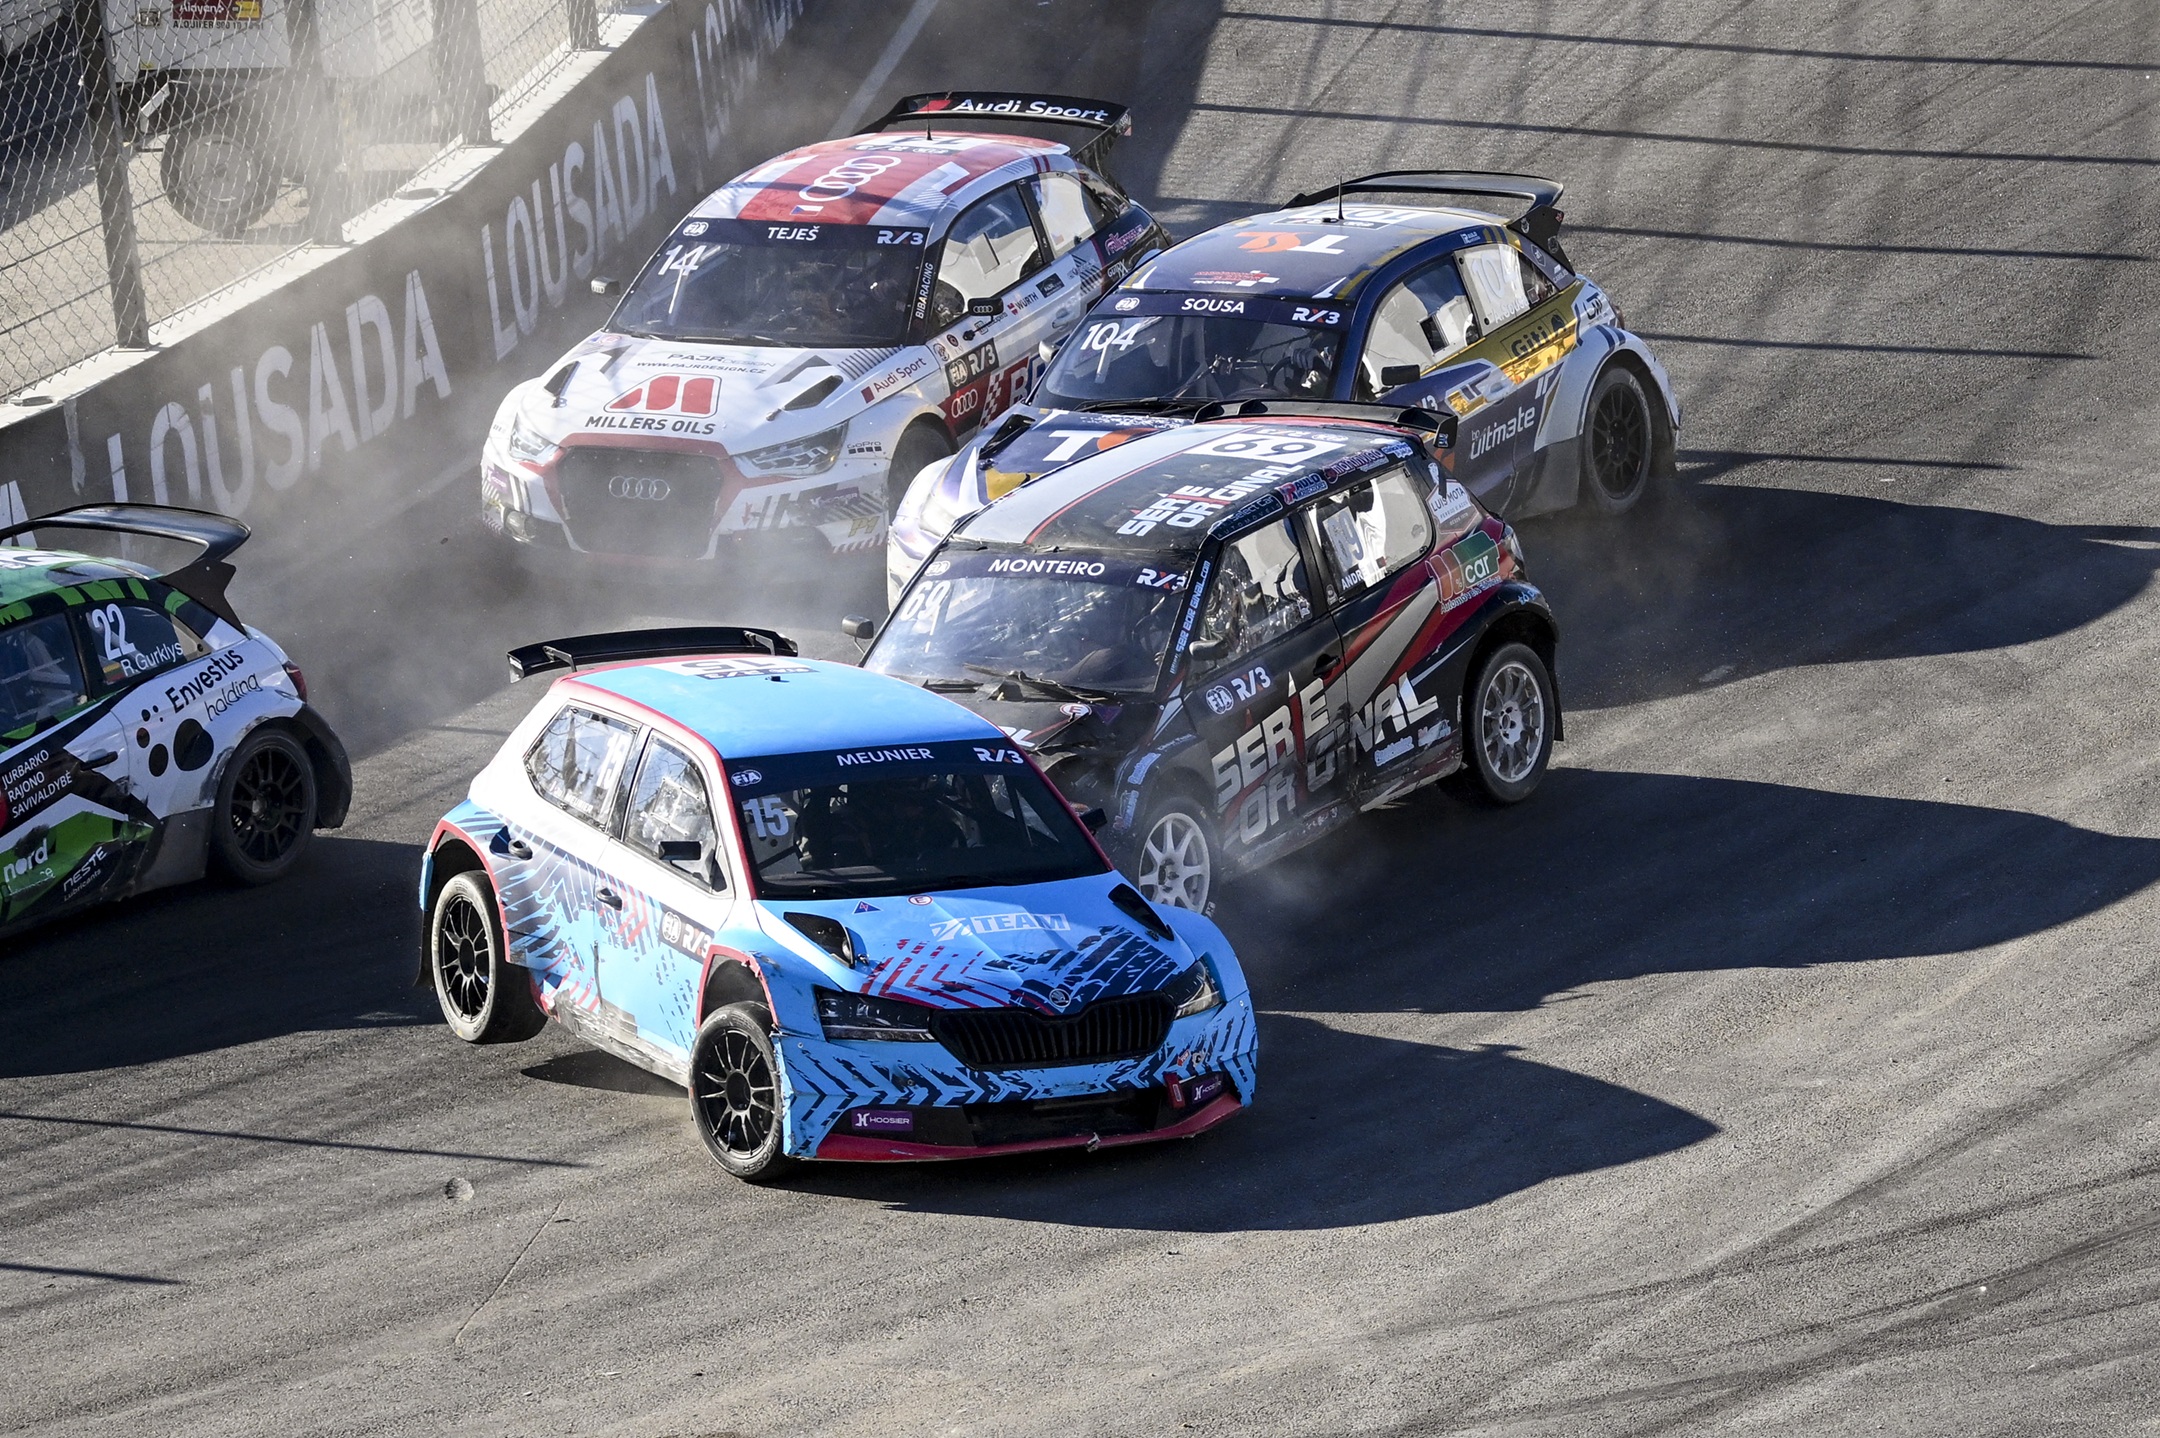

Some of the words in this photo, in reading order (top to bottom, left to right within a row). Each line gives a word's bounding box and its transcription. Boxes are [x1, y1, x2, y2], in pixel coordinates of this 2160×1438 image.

[955, 98, 1021, 113] Audi
[1025, 101, 1109, 121] Sport
[482, 72, 676, 355] LOUSADA
[767, 226, 820, 241] TEJEŠ
[657, 245, 707, 276] 14
[915, 263, 934, 320] BIBARACING
[1181, 298, 1245, 314] SOUSA
[1080, 322, 1137, 351] 104
[1510, 326, 1551, 359] Giti
[873, 371, 896, 394] Audi
[895, 356, 928, 381] Sport
[107, 268, 452, 557] LOUSADA
[585, 415, 668, 431] MILLERS
[671, 420, 716, 435] OILS
[1430, 492, 1449, 511] LUIS
[1448, 488, 1465, 503] MOTA
[988, 558, 1105, 576] MONTEIRO
[1465, 555, 1490, 583] car
[92, 603, 136, 660] 22
[120, 641, 184, 677] R.Gurklys
[165, 649, 244, 713] Envestus
[2, 749, 50, 790] JURBARKO
[837, 748, 934, 767] MEUNIER
[8, 771, 45, 802] RAJONO
[11, 771, 73, 818] SAVIVALDYBĖ
[743, 797, 789, 838] 15
[3, 838, 48, 883] nord
[978, 912, 1067, 933] TEAM
[869, 1116, 910, 1125] HOOSIER
